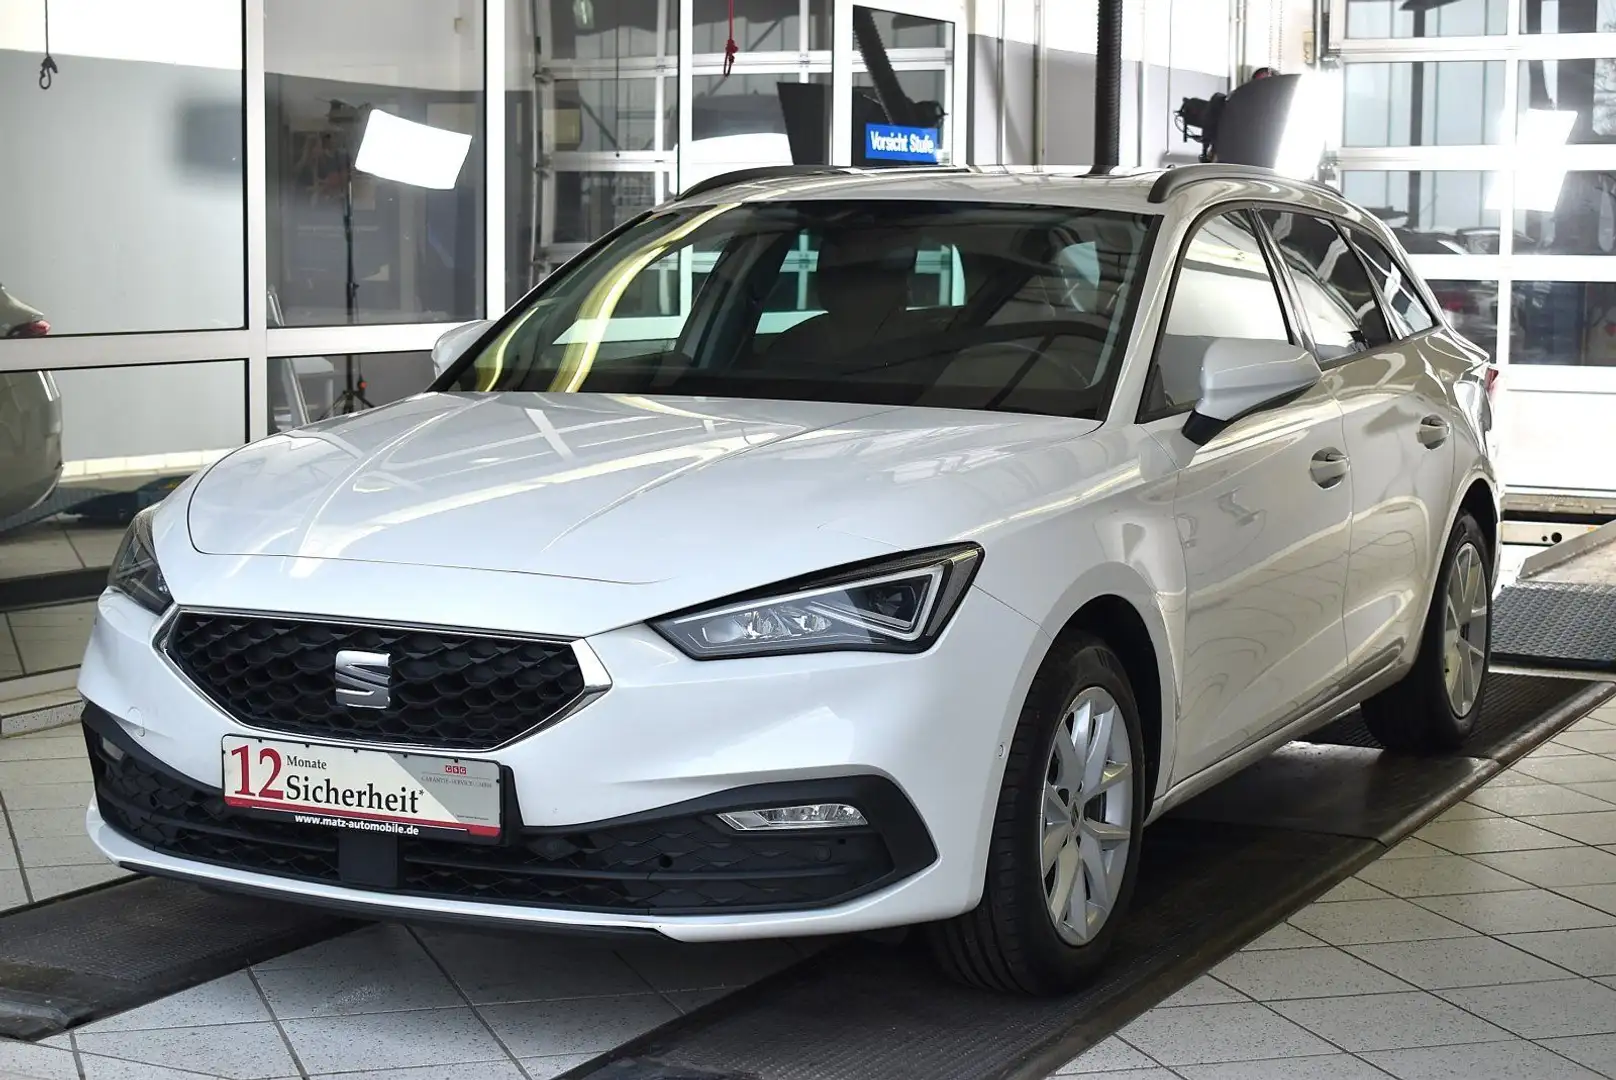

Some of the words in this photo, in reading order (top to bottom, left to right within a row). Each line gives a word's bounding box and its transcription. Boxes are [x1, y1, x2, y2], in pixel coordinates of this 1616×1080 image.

[870, 130, 908, 152] Vorsicht
[231, 744, 284, 800] 12
[286, 754, 327, 770] Monate
[295, 814, 419, 835] www.matz-automobile.de
